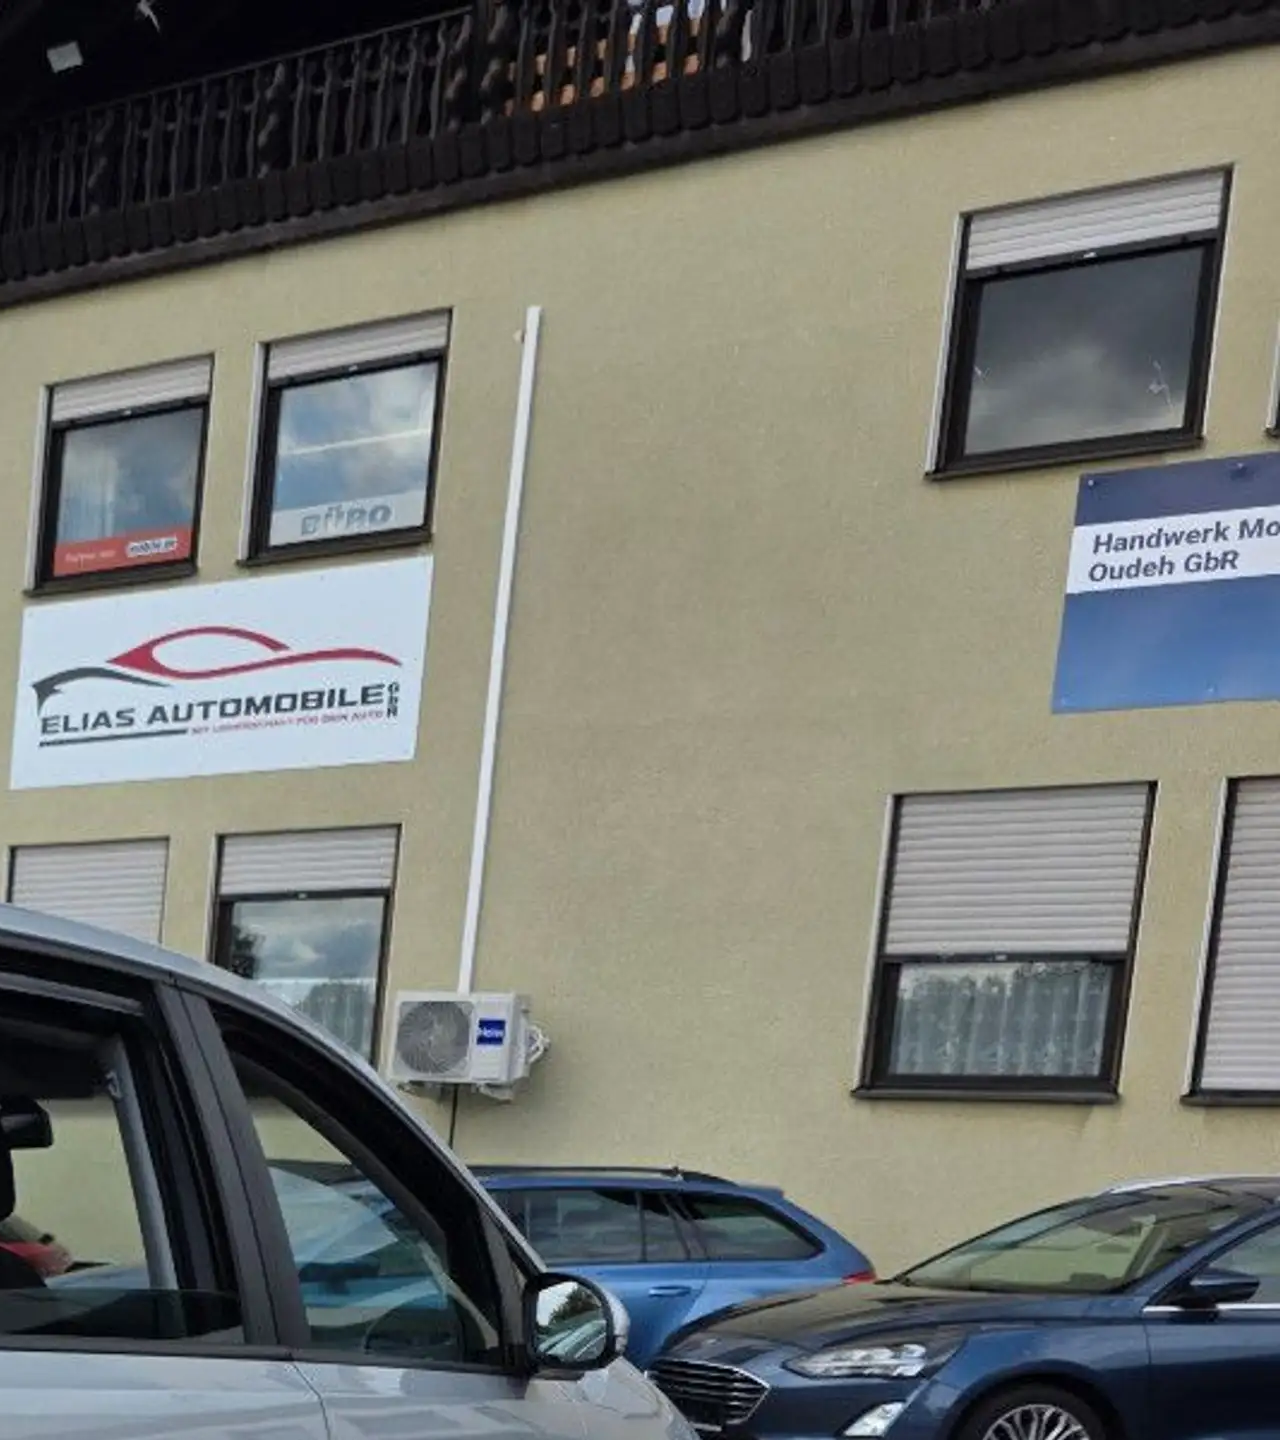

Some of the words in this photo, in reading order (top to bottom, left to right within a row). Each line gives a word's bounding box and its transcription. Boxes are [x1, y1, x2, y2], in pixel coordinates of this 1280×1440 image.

[1092, 520, 1229, 555] Handwerk
[1089, 556, 1175, 582] Oudeh
[1184, 550, 1240, 575] GbR
[41, 708, 136, 734] ELIAS
[147, 685, 385, 725] AUTOMOBILE
